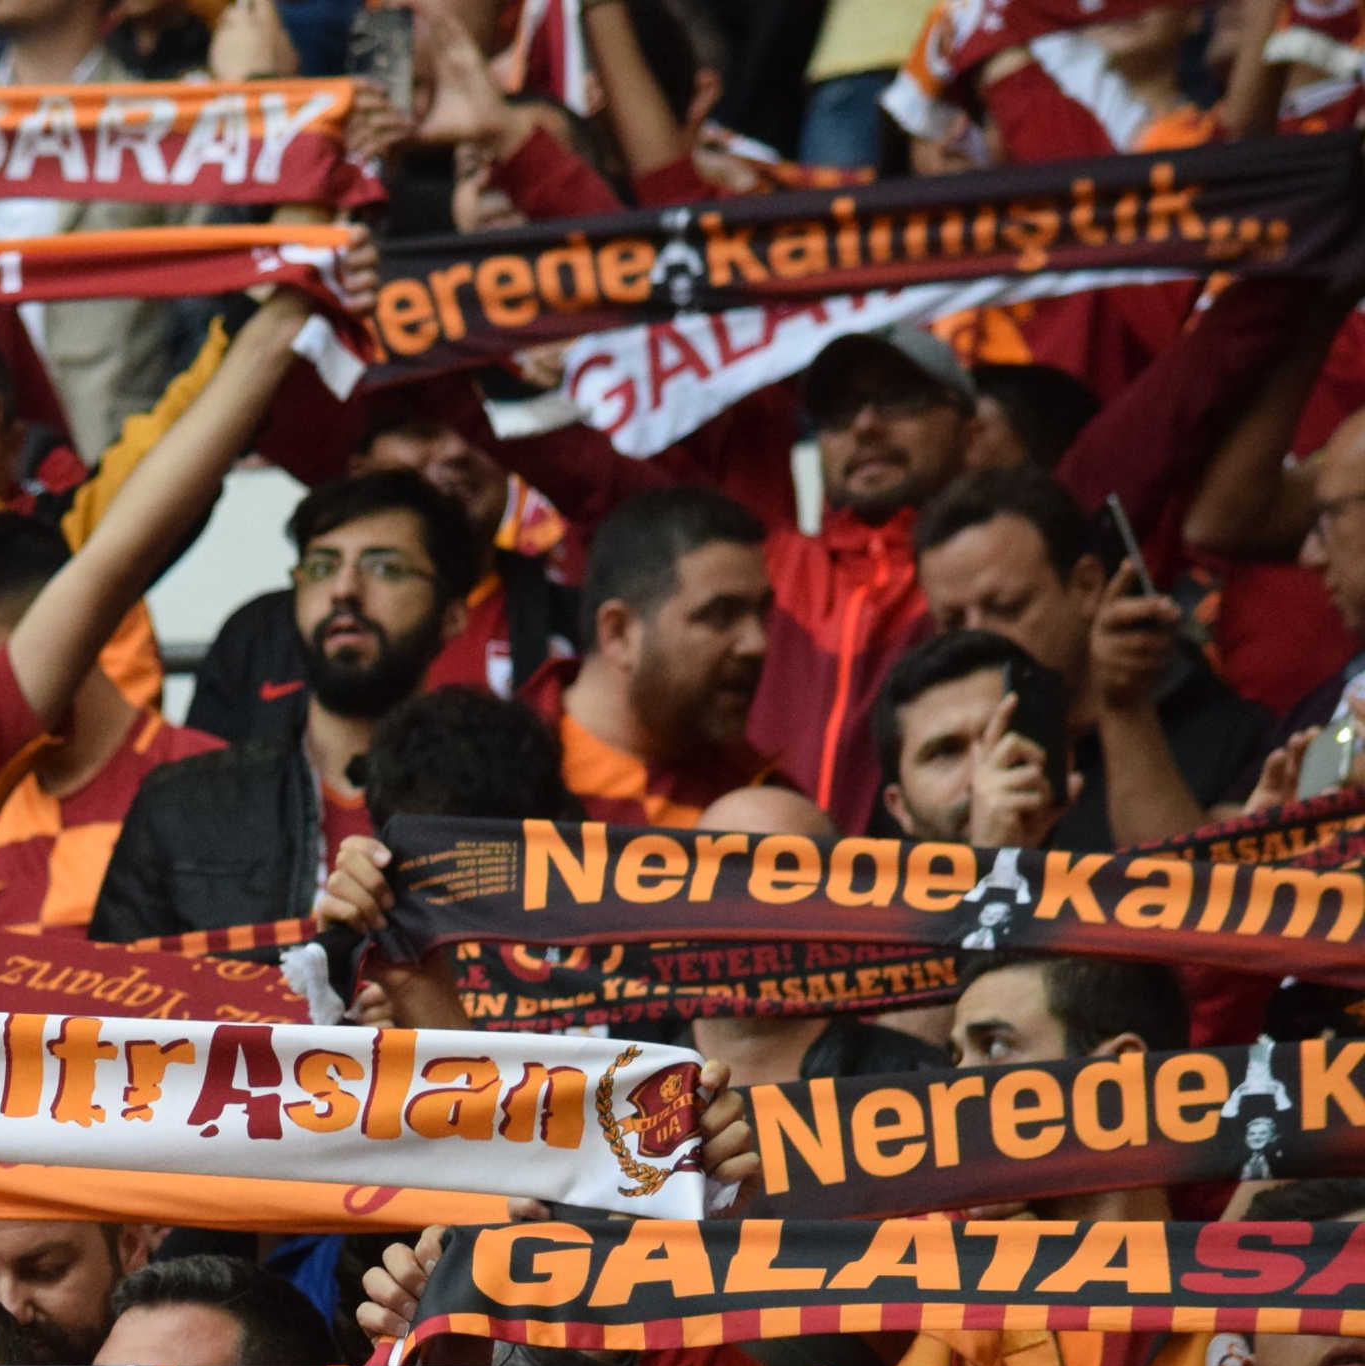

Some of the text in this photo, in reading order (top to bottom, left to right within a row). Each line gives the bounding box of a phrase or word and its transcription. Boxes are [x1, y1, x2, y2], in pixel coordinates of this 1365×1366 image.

[374, 237, 655, 362] erede
[522, 817, 977, 914] Nerede
[751, 1052, 1232, 1197] Nerede
